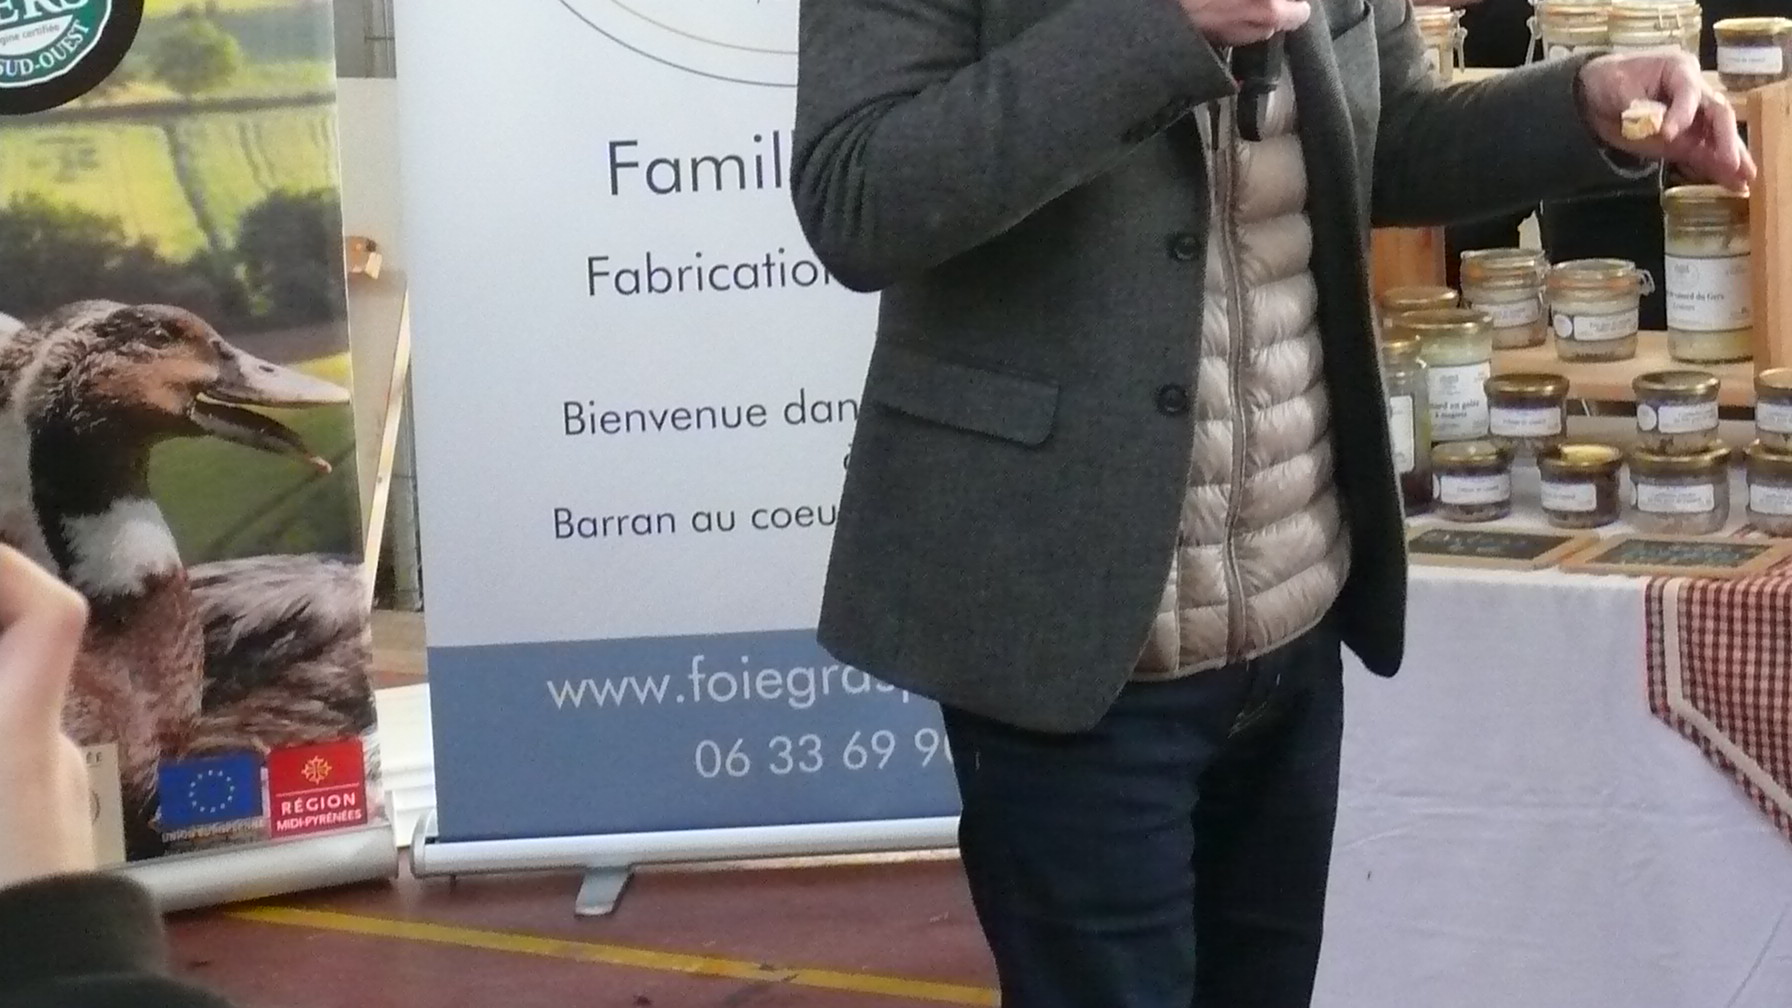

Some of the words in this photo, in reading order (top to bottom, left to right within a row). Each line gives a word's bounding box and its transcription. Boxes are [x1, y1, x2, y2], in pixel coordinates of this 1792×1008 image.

[0, 19, 90, 77] UD-OUEST
[22, 23, 61, 39] certifiée
[607, 130, 796, 196] Famil
[563, 400, 768, 436] Bienvenue
[784, 389, 859, 426] dan
[553, 507, 677, 540] Barran
[691, 508, 737, 535] au
[751, 502, 837, 531] coeu
[547, 655, 909, 710] www.foiegra
[696, 738, 751, 778] 06
[768, 734, 824, 774] 33
[843, 729, 896, 769] 69
[276, 808, 363, 832] MIDI-PYRÉNÉES
[280, 791, 356, 816] RÉGION
